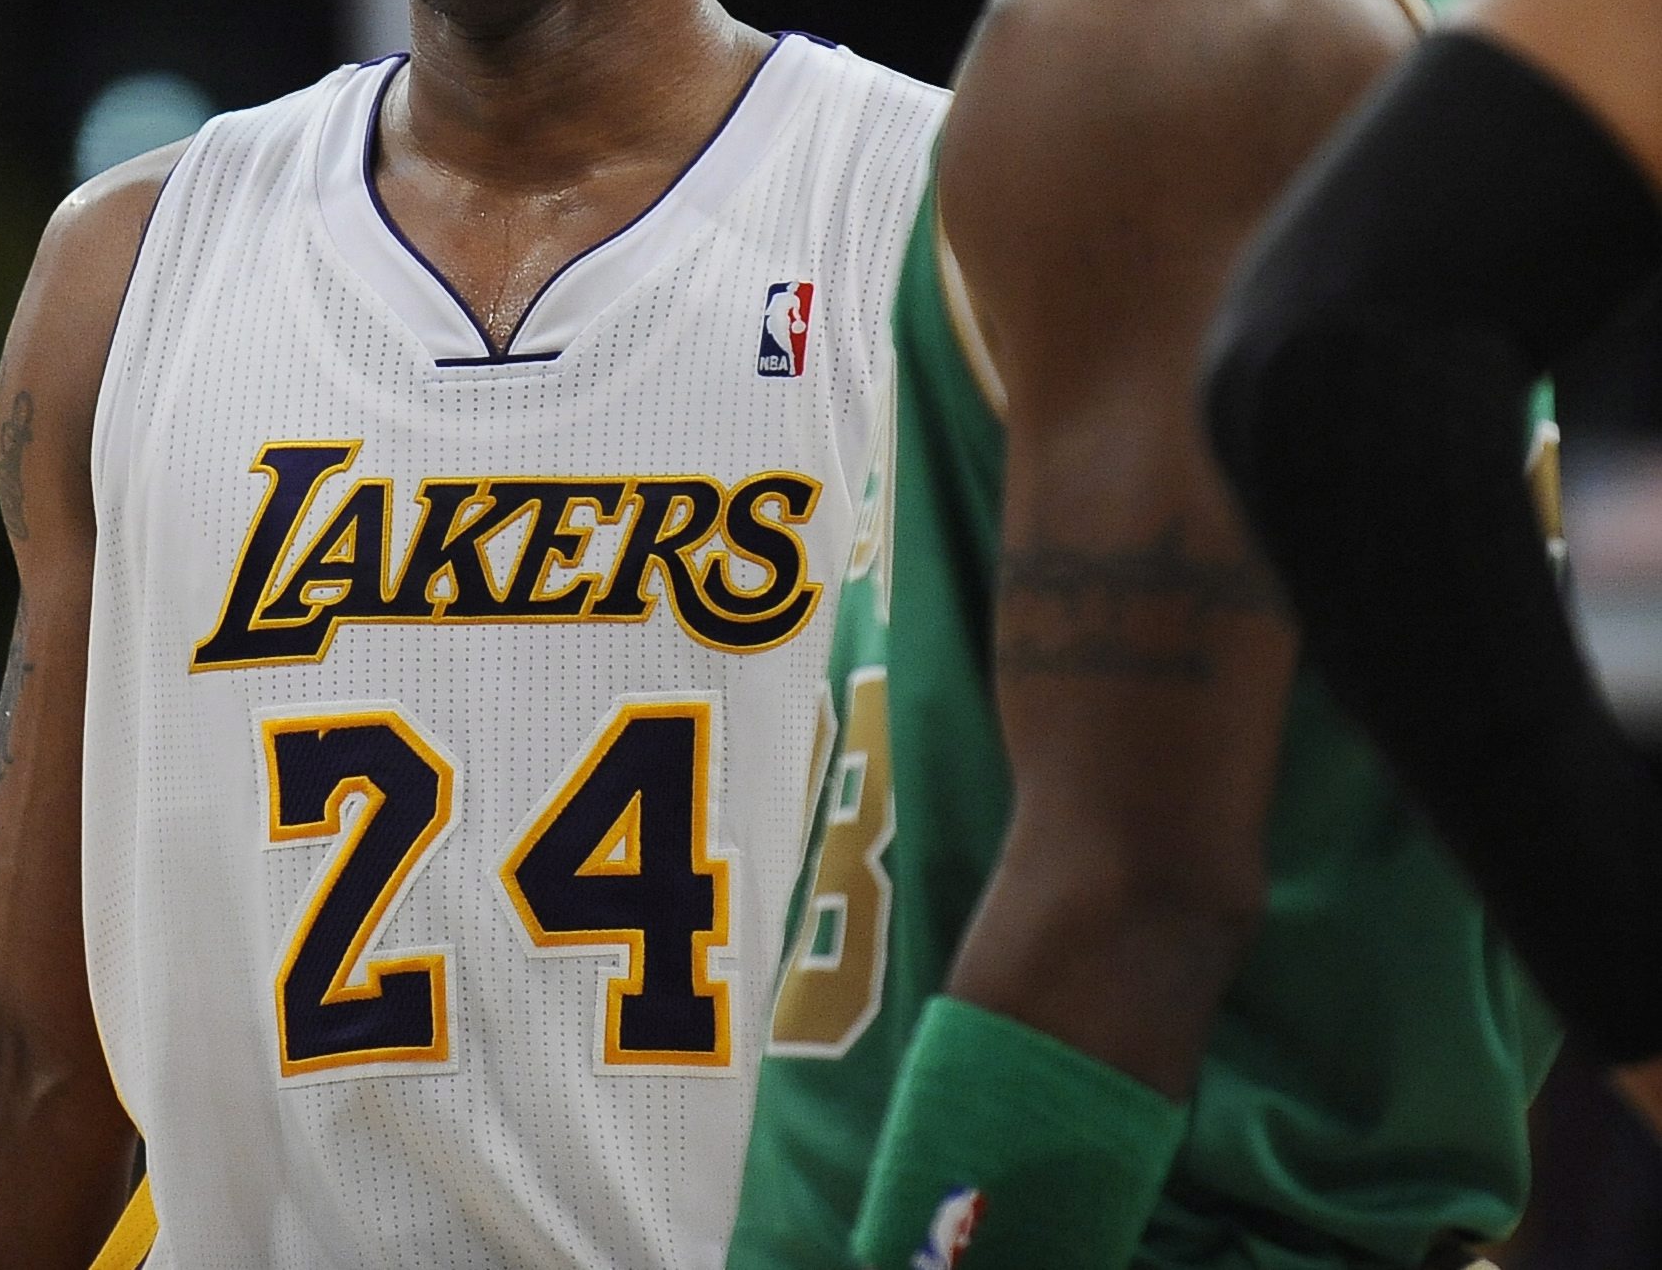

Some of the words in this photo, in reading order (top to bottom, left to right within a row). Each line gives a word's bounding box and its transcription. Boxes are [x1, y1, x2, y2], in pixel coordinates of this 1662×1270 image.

[760, 356, 788, 371] NBA
[188, 438, 824, 674] LAKERS
[258, 698, 733, 1080] 24
[766, 662, 896, 1060] 8
